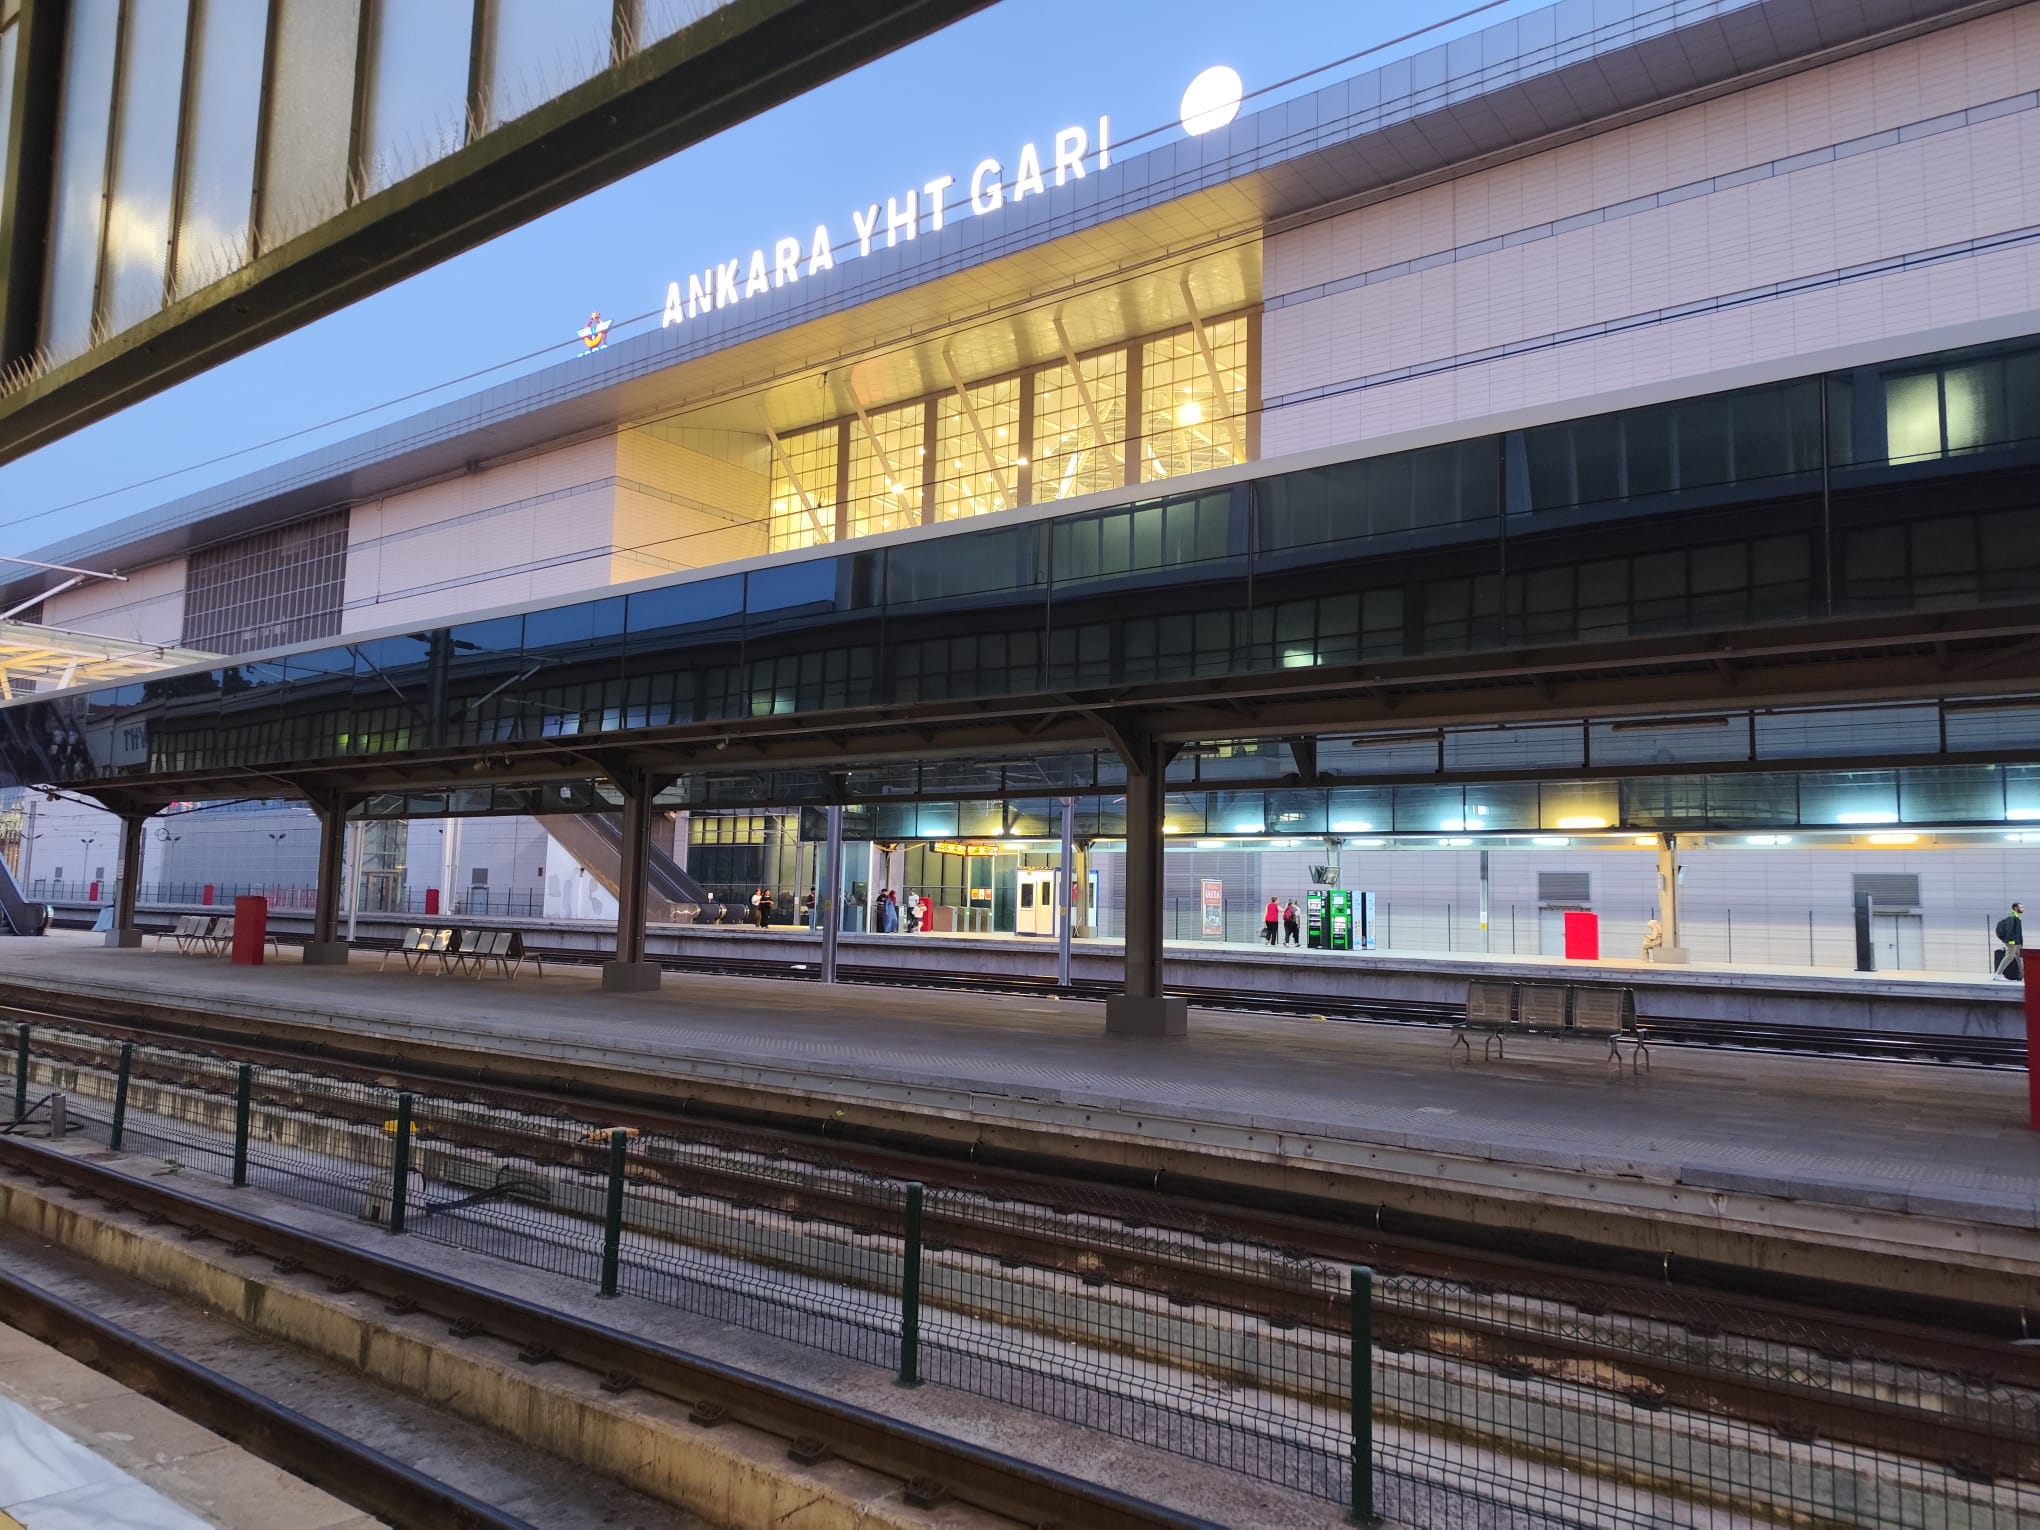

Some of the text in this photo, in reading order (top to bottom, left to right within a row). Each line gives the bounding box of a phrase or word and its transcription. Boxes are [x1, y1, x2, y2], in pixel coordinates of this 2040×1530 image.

[662, 114, 1109, 329] ANKARA YHT GARI
